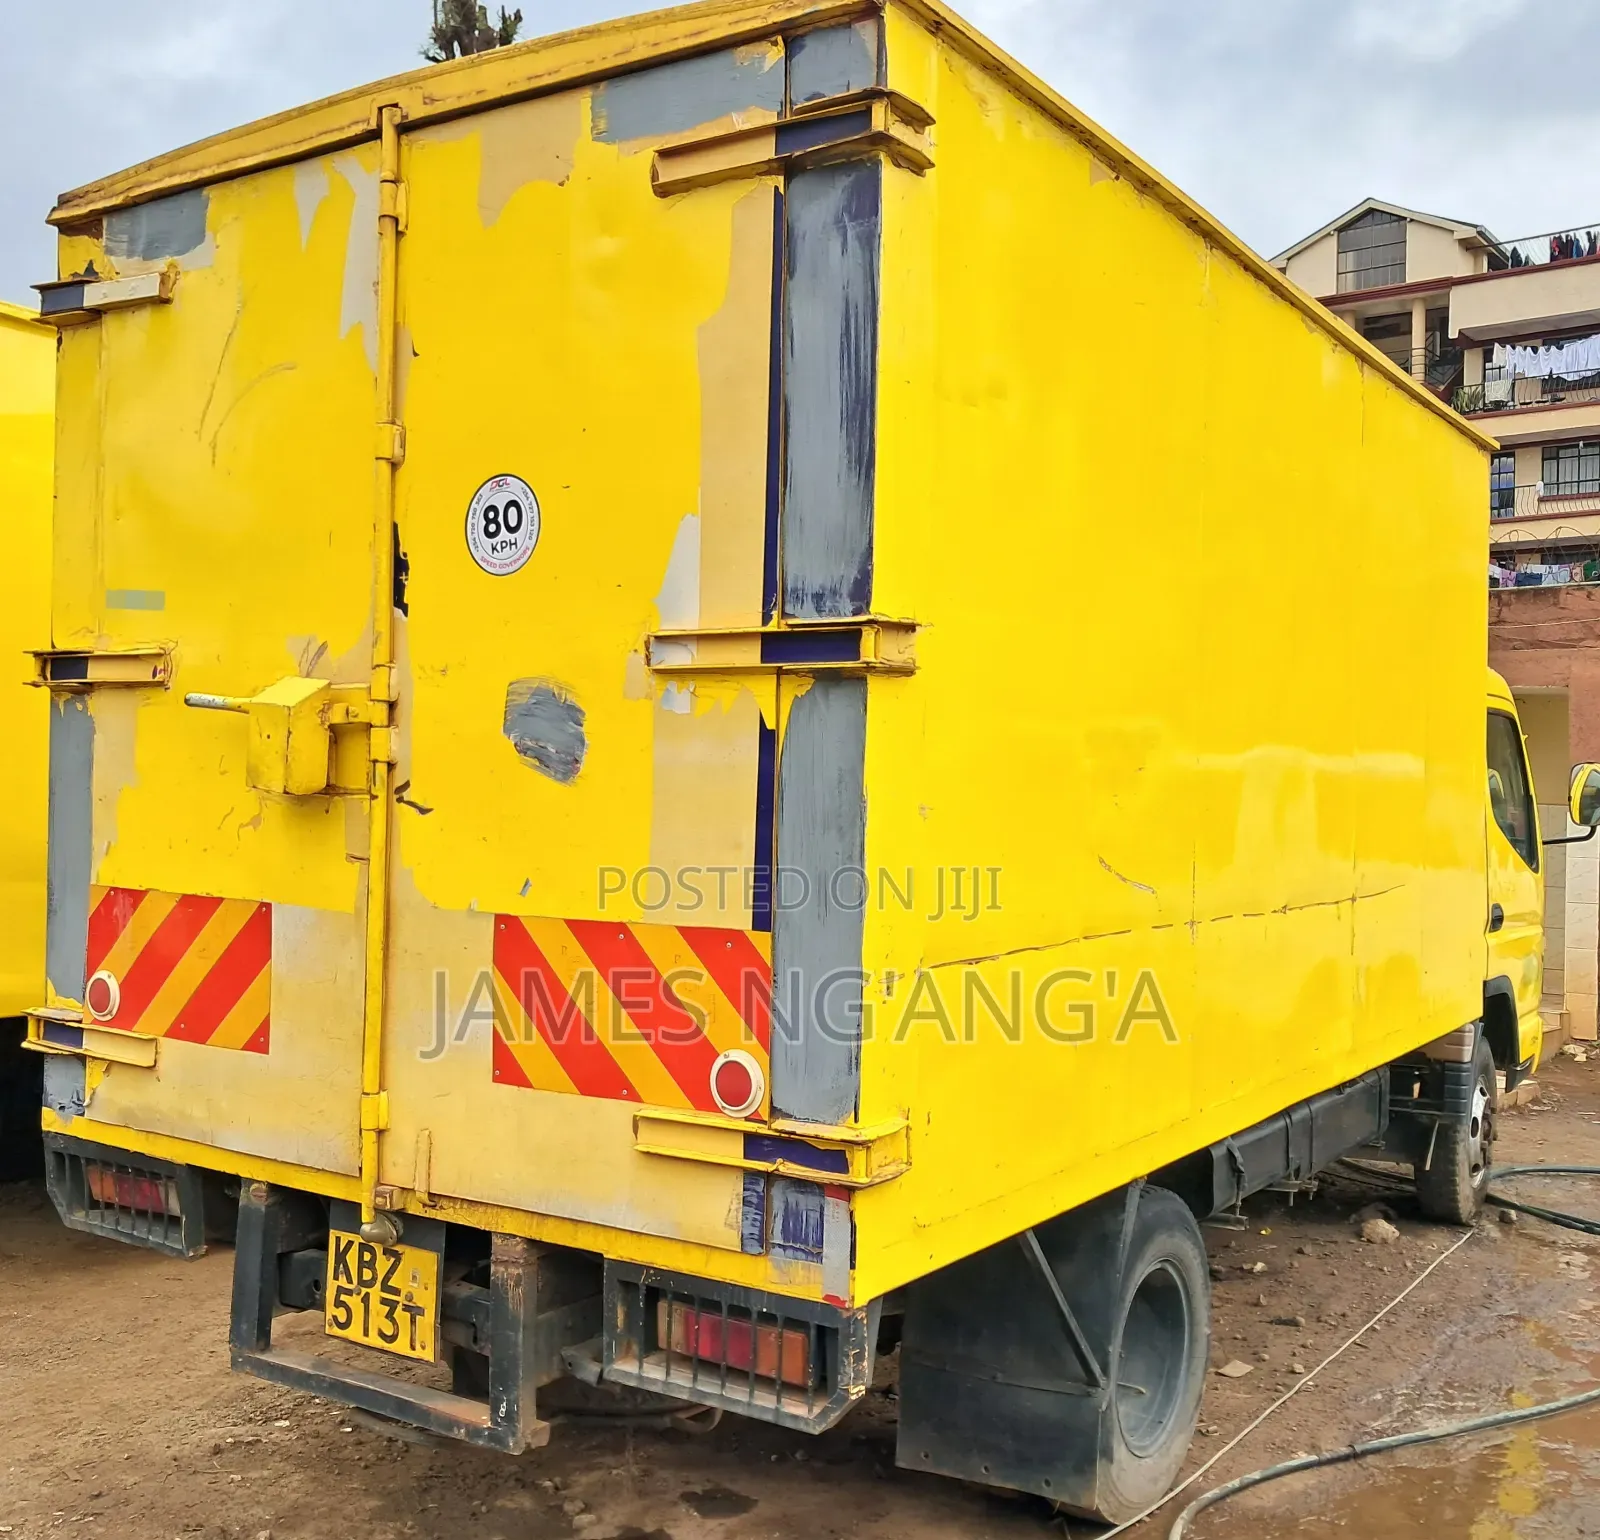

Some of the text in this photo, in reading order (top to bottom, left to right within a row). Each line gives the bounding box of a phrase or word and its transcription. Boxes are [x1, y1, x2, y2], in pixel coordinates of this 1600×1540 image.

[483, 499, 523, 539] 80
[480, 555, 498, 569] SPEED
[491, 537, 518, 555] KPH
[333, 1236, 404, 1297] KBZ
[331, 1285, 425, 1352] 513T
